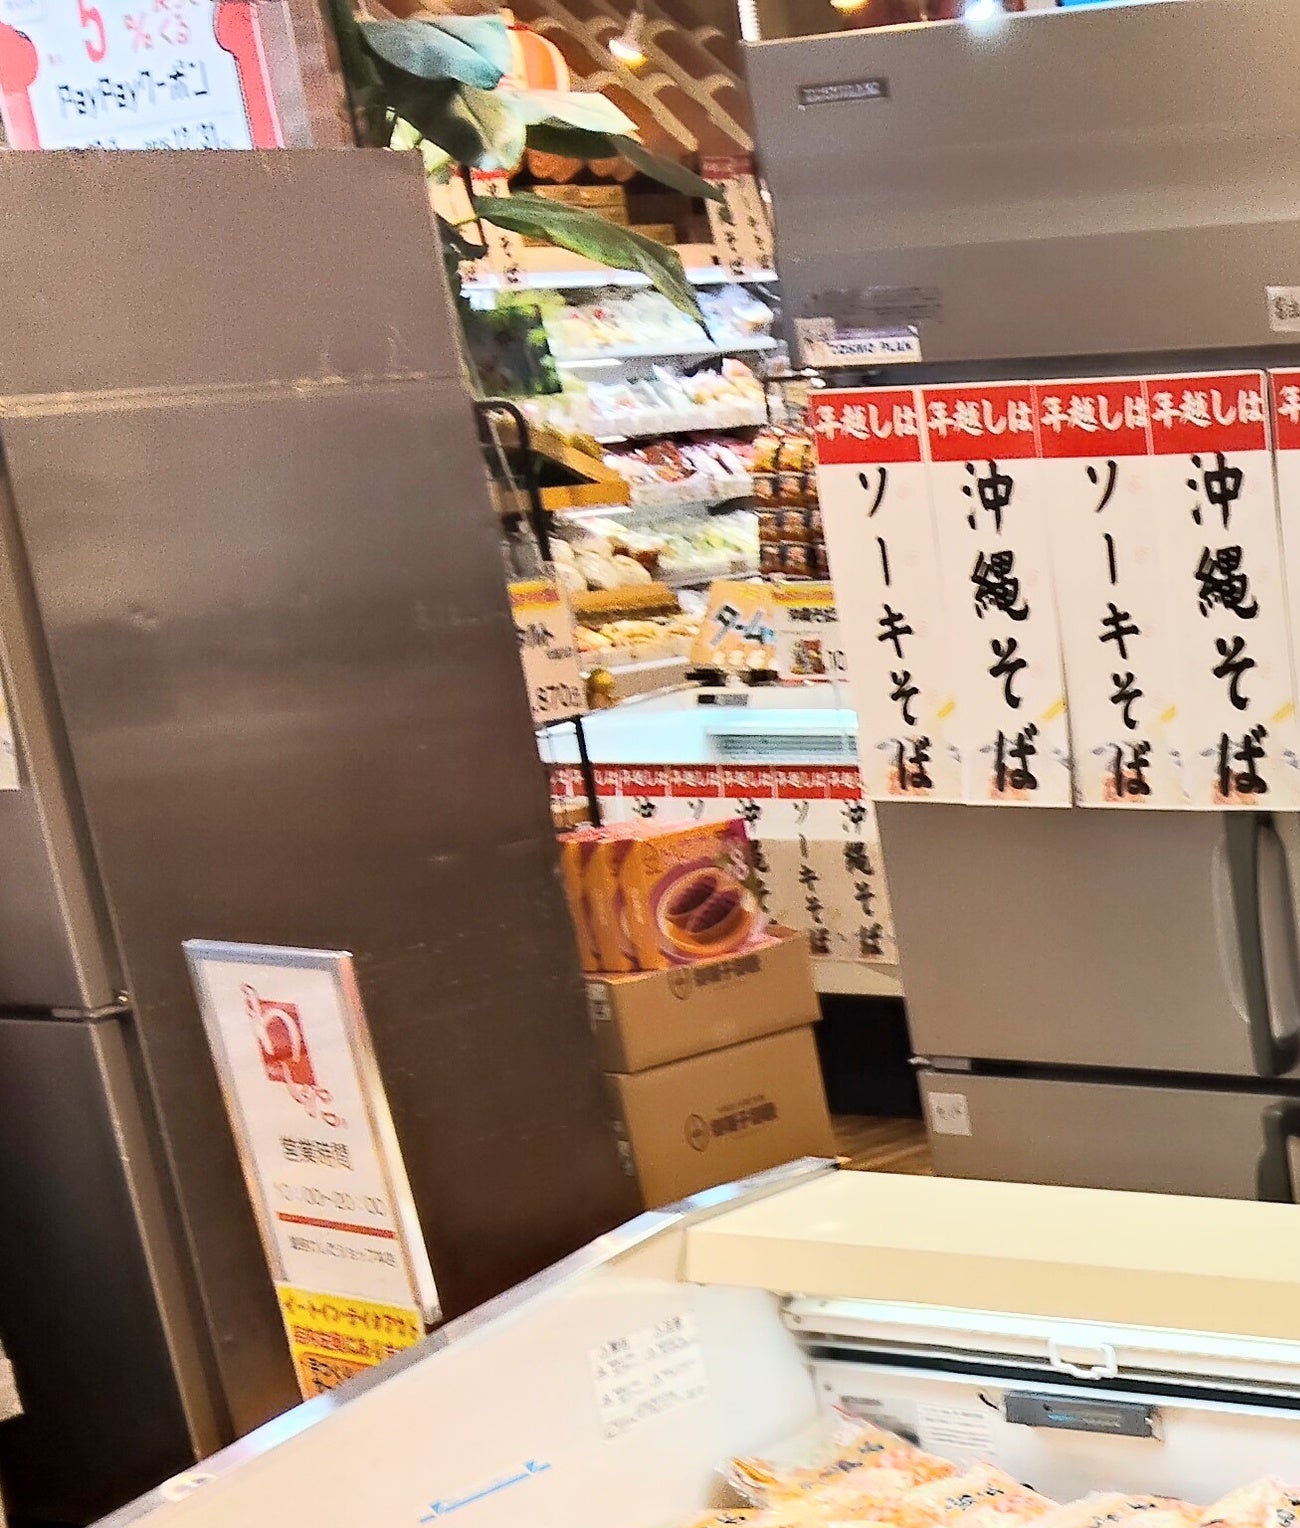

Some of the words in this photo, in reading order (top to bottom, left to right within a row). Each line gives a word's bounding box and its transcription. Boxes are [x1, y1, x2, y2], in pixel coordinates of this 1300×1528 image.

[927, 398, 1033, 440] 年越しは
[1152, 387, 1265, 430] 年越しは
[857, 466, 933, 791] ソーキそば
[962, 458, 1040, 794] 沖縄そば
[1086, 460, 1153, 797] ソーキそば
[1186, 452, 1268, 797] 沖縄そば
